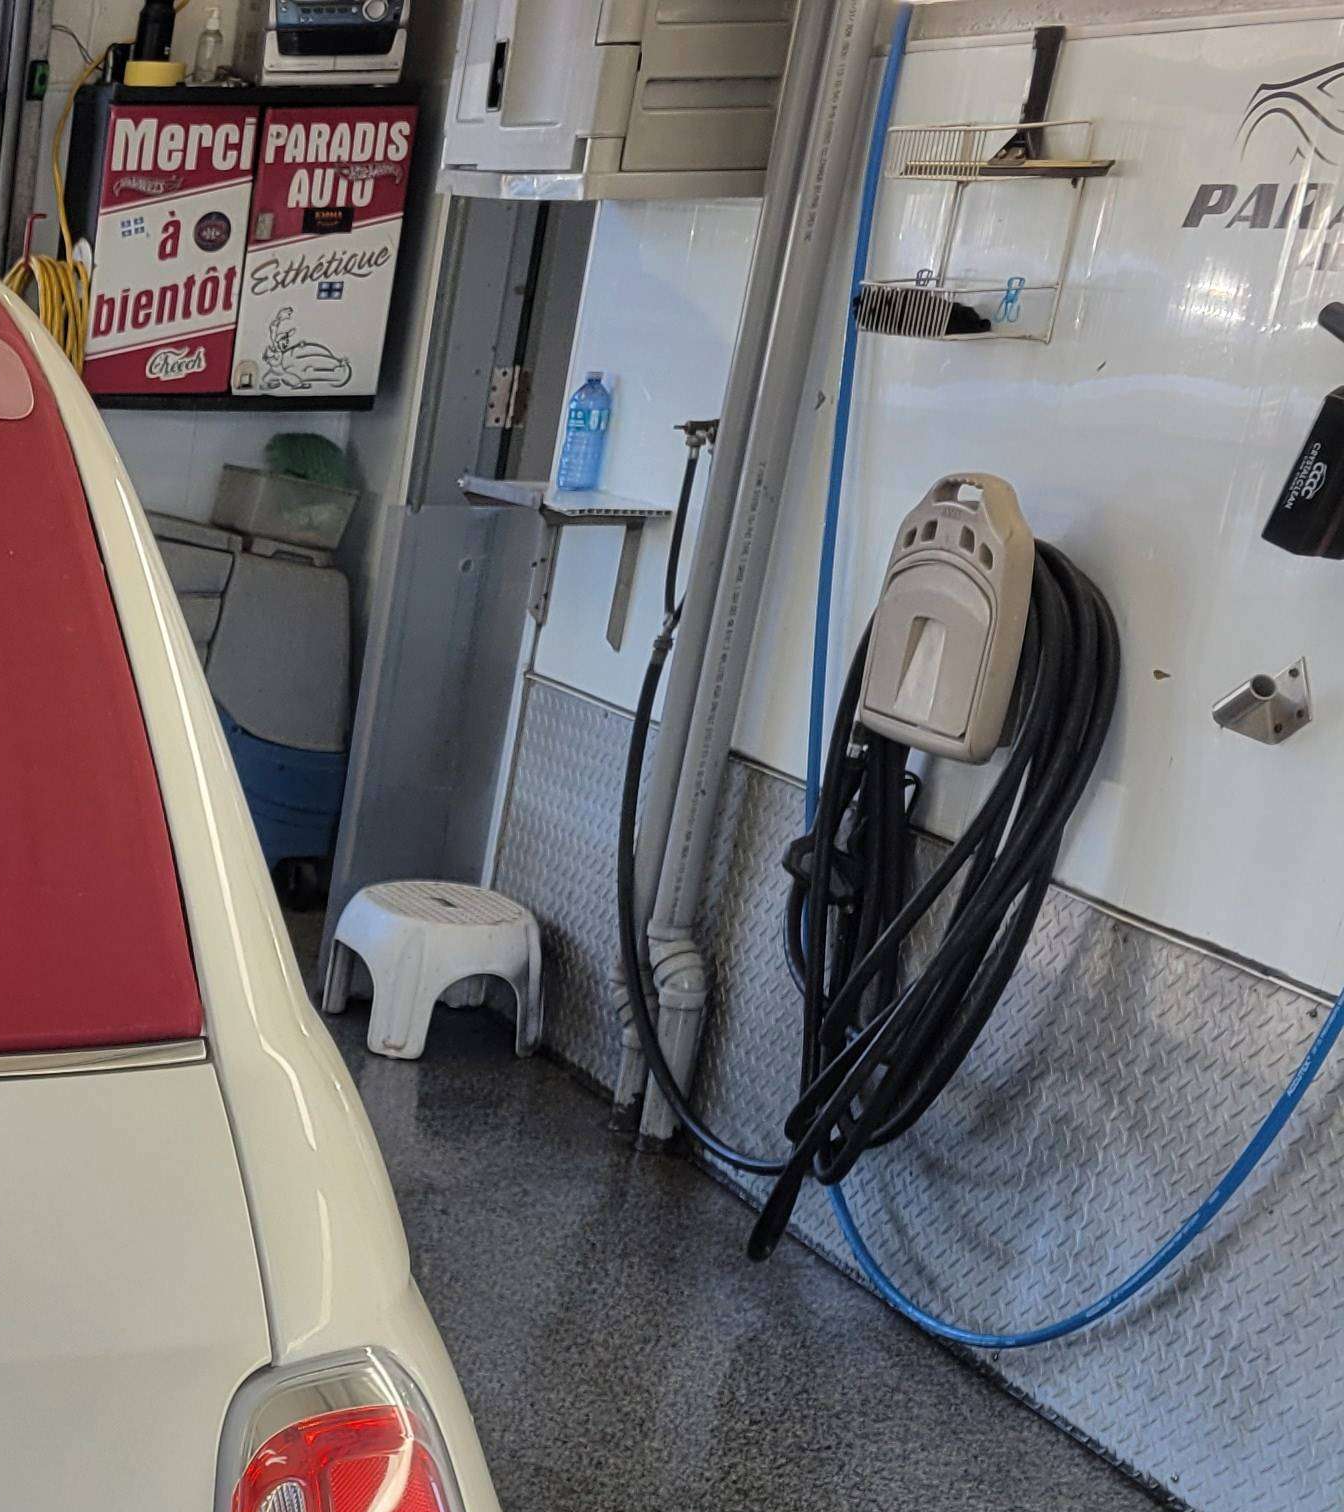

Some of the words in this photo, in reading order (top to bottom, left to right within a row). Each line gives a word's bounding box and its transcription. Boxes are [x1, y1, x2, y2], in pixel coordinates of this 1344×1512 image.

[111, 117, 257, 172] Merci
[265, 121, 411, 164] PARADIS
[158, 210, 181, 261] à
[250, 246, 392, 296] Esthétique
[91, 265, 237, 339] bientôt
